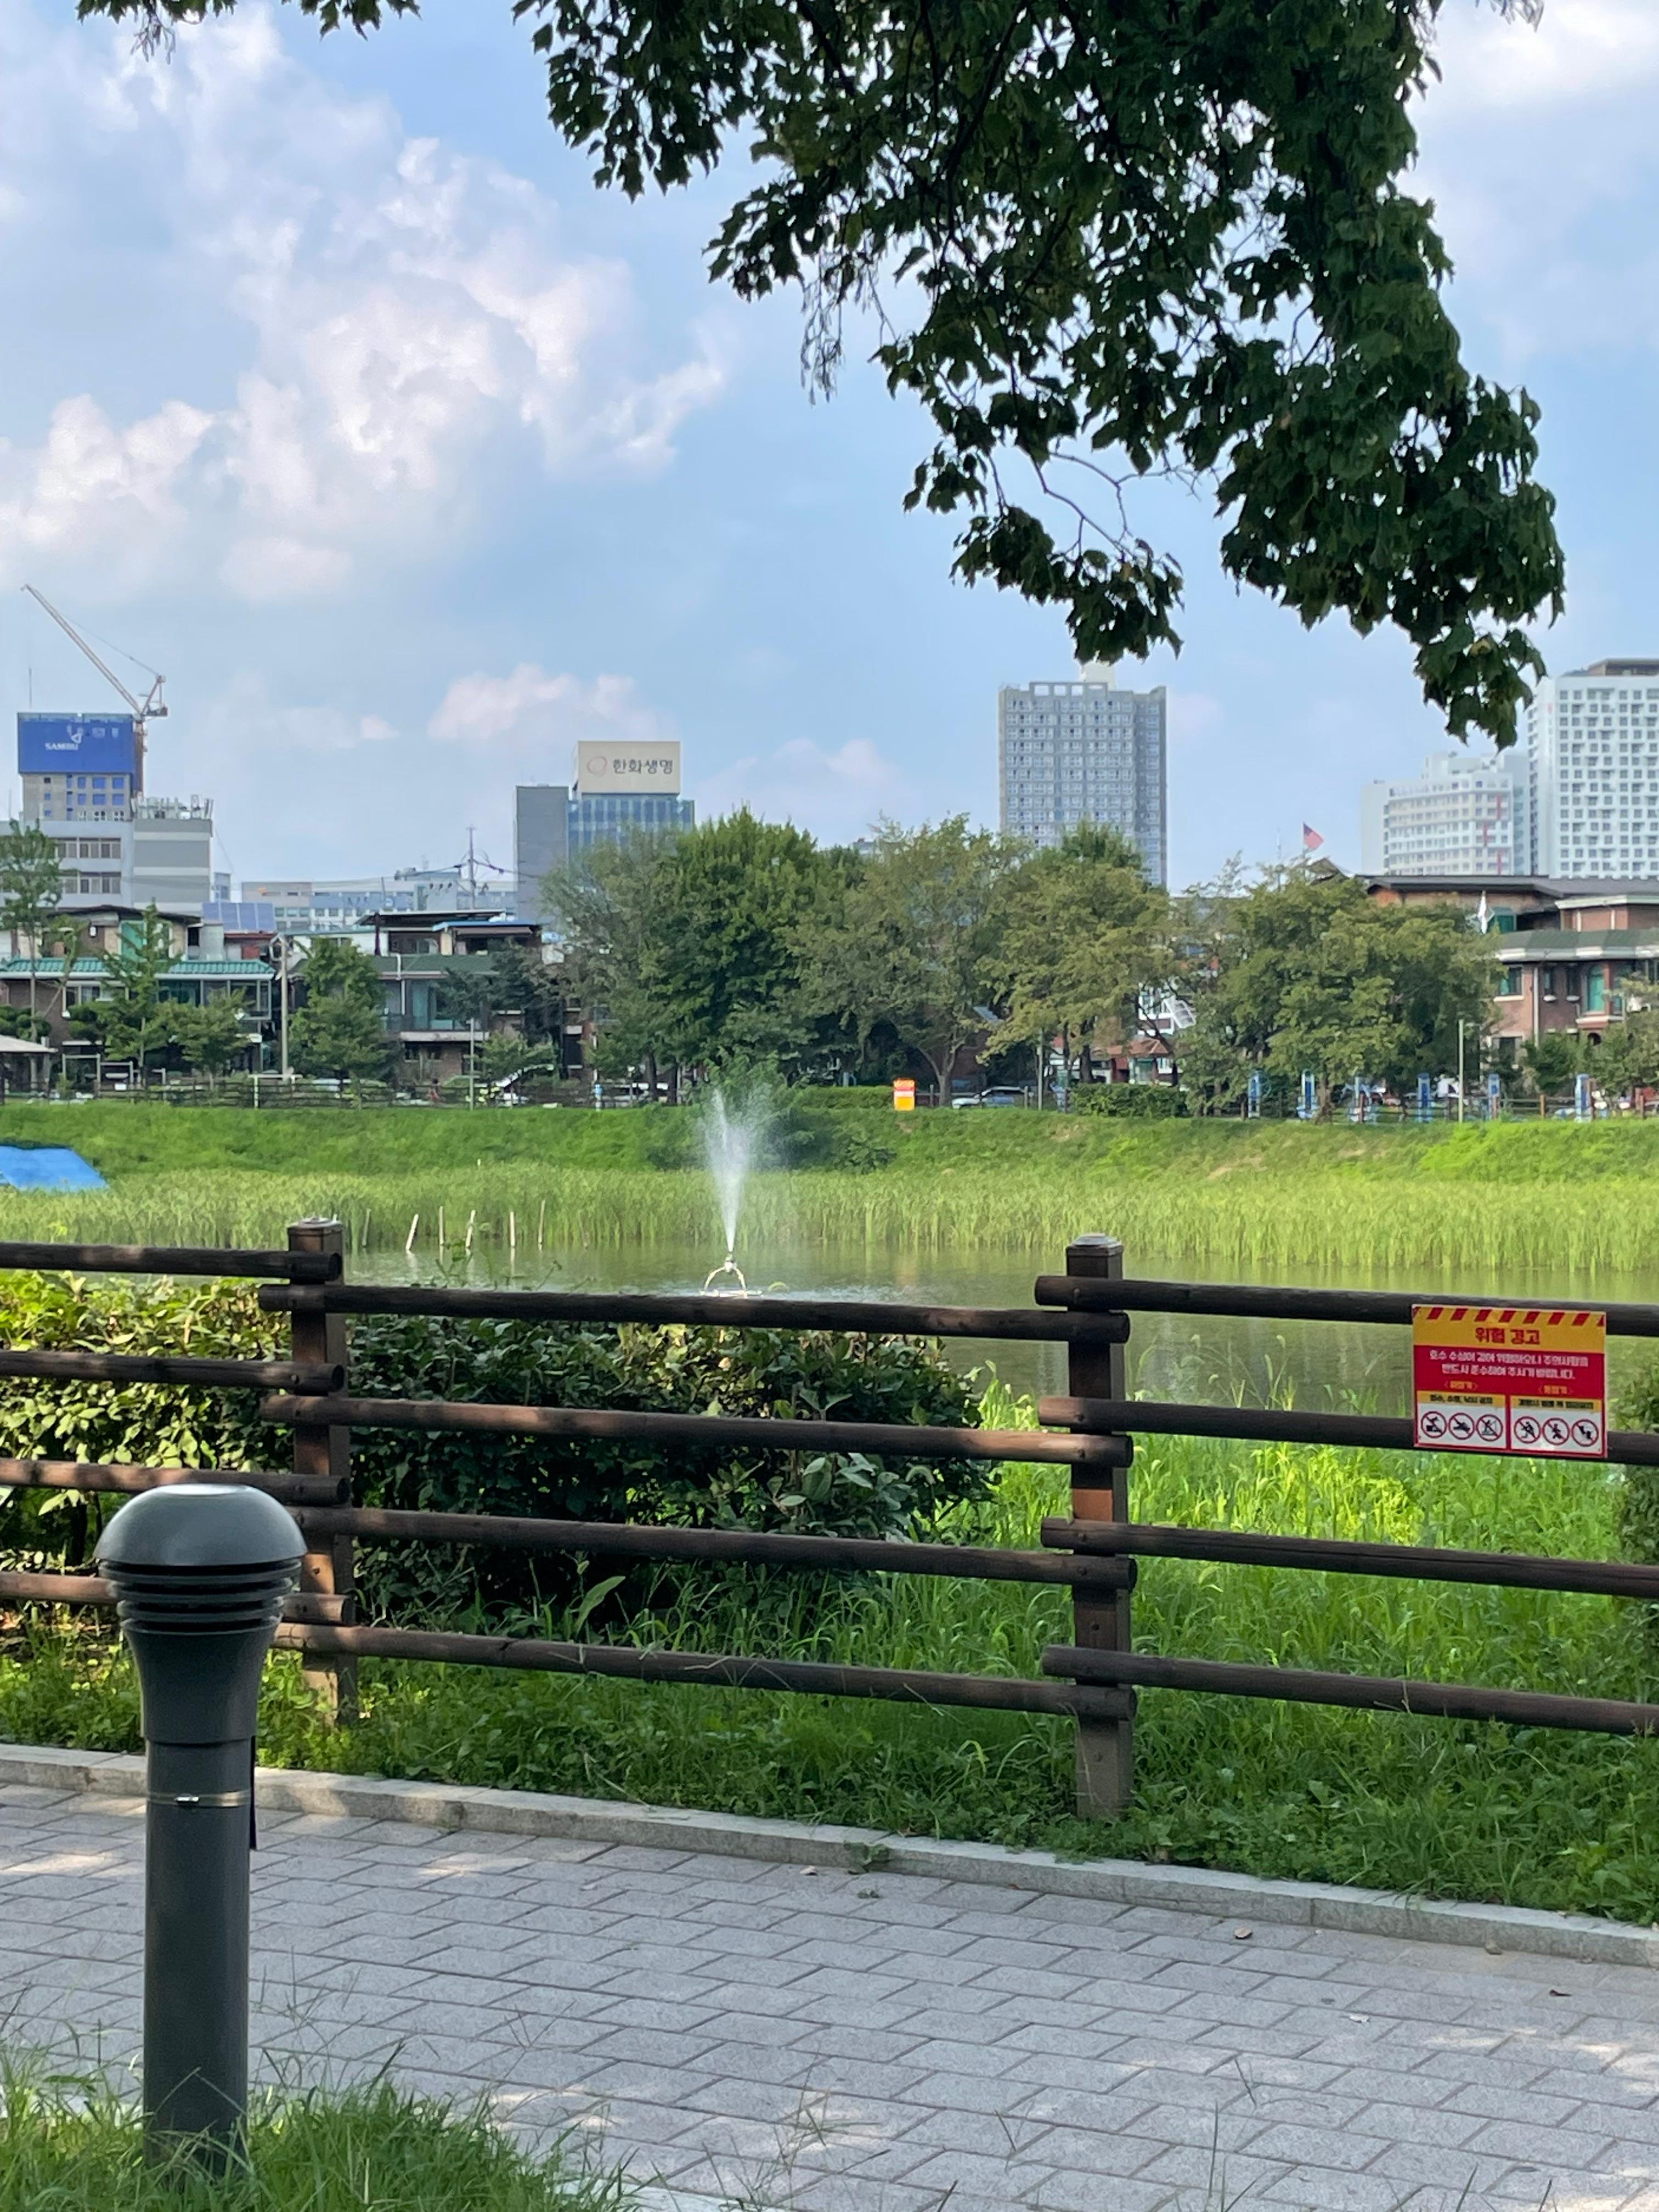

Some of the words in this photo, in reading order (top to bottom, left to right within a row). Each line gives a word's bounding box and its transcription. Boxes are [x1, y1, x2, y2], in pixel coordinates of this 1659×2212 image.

[613, 759, 673, 774] 한화생명
[1475, 1327, 1505, 1343] 위험
[1510, 1329, 1540, 1344] 경고
